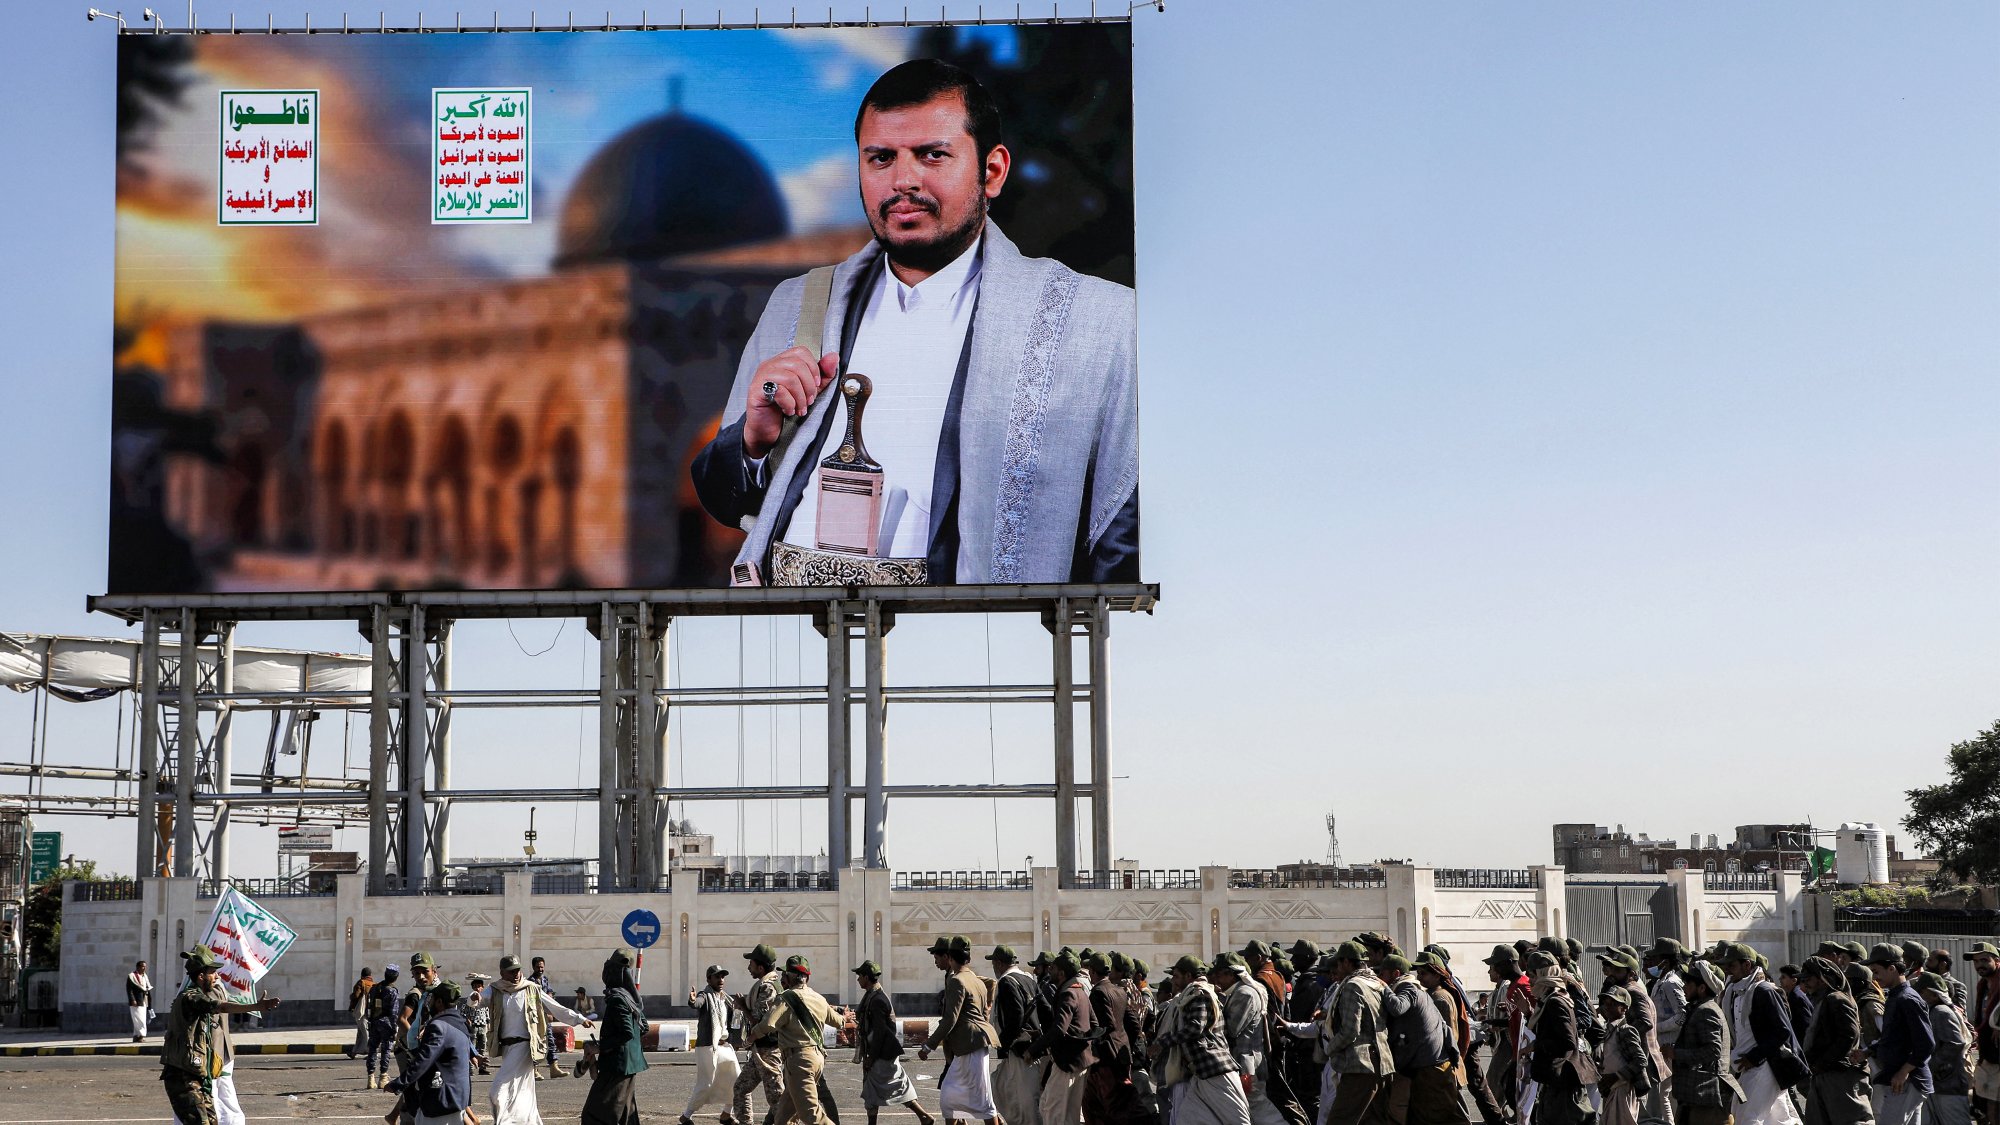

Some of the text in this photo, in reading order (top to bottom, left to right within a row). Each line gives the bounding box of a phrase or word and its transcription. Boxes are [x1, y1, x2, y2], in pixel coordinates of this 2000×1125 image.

[229, 98, 310, 132] قاطعوا
[438, 93, 524, 125] الله أكبر
[440, 123, 523, 144] الموت لأمريكا
[225, 136, 312, 164] البضائع الأمريكية
[439, 148, 523, 166] الموت لإسرائيل
[264, 164, 270, 184] و
[439, 170, 523, 188] اللعنة على اليهود
[226, 188, 312, 214] الإسرائيلية
[439, 189, 523, 216] النصر للإسلام
[255, 925, 286, 952] الله
